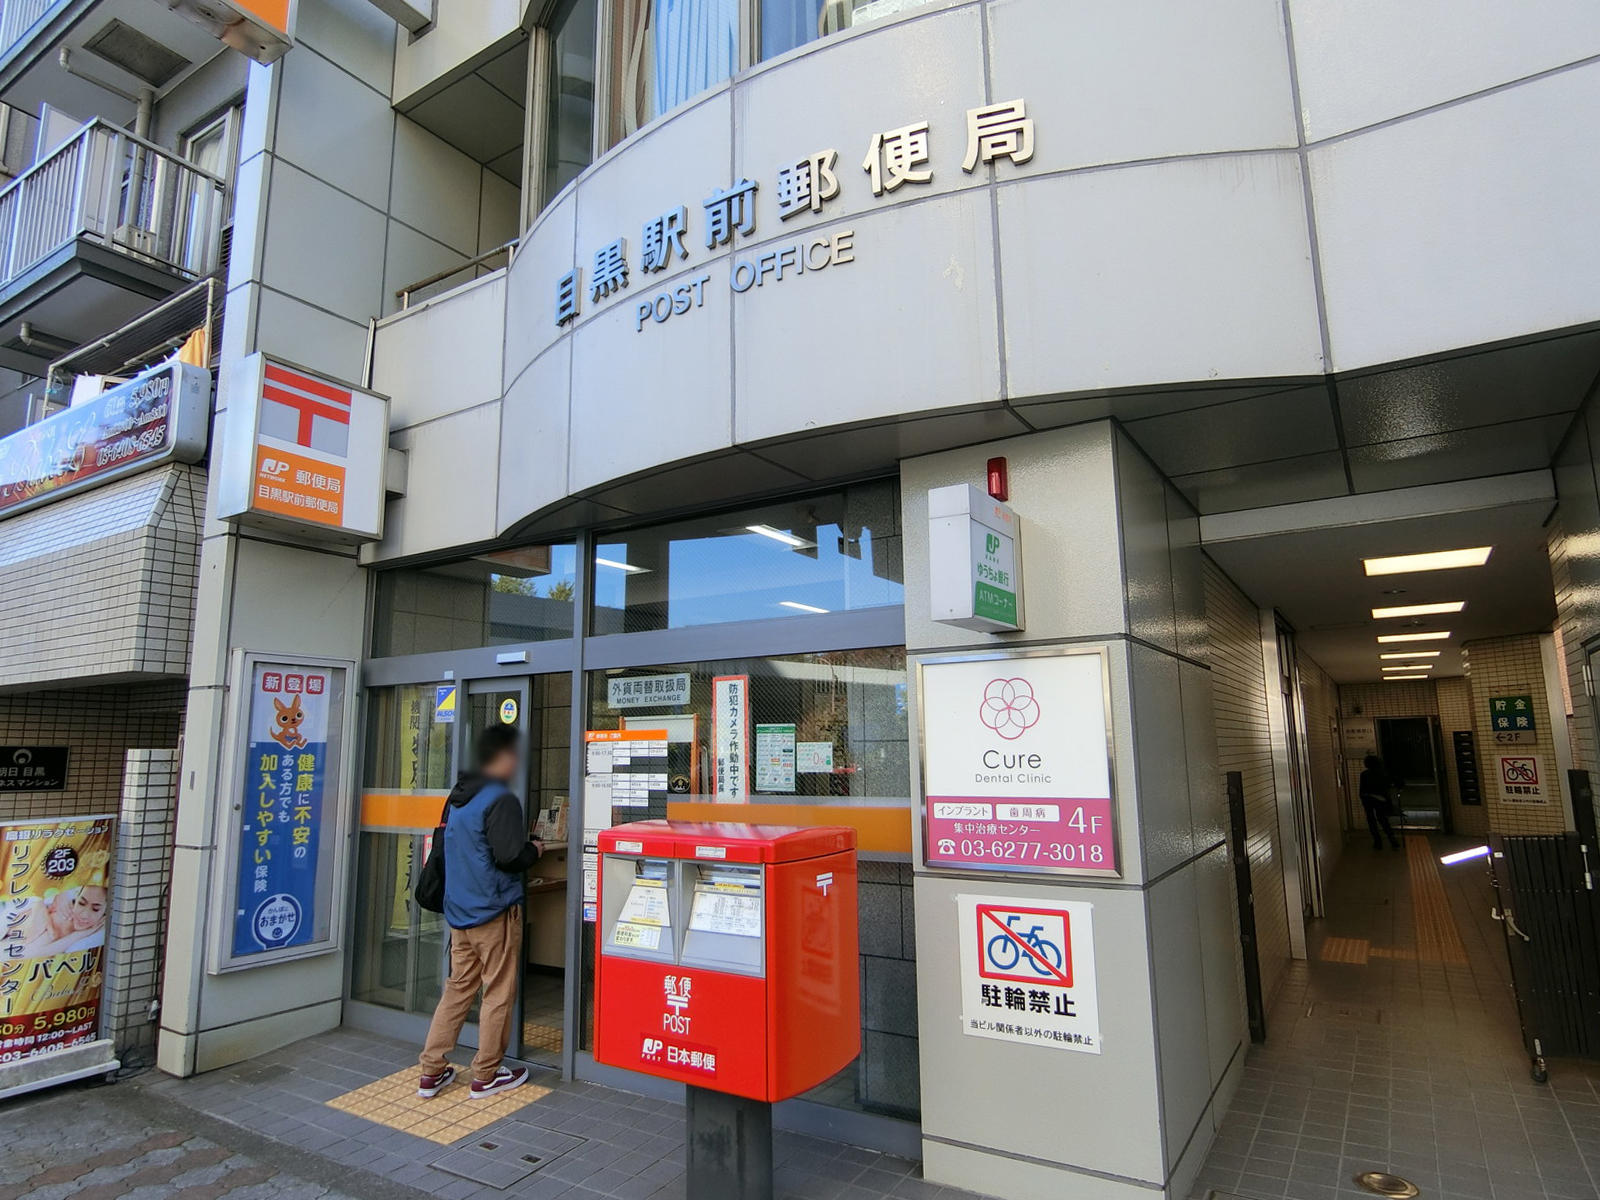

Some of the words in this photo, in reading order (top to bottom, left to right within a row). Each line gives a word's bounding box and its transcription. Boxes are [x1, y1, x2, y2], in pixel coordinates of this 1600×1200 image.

[555, 98, 1036, 327] 目黒駅前郵便局
[635, 276, 710, 332] POST
[730, 230, 855, 293] OFFICE
[261, 458, 290, 475] JP
[259, 472, 286, 483] NETWORK
[295, 469, 341, 493] 郵便局
[258, 484, 339, 515] 目黒駅前郵便局
[986, 533, 999, 554] JP
[977, 562, 1010, 586] ゆうちょ銀行
[980, 588, 1013, 609] ATMコーナー
[264, 674, 324, 693] 新登場
[612, 677, 686, 696] 外貨両替取扱局
[644, 694, 681, 703] EXCHANGE
[1495, 699, 1526, 711] 貯金
[1497, 716, 1528, 728] 保険
[728, 683, 739, 798] 防犯カメラ作動中です
[1507, 732, 1521, 742] 2F
[982, 749, 1042, 769] Cure
[23, 767, 46, 777] 目黒
[717, 758, 725, 793] 郵便局長
[974, 773, 1013, 784] Dental
[1017, 773, 1051, 784] Clinic
[278, 754, 295, 823] ある方でも
[293, 754, 315, 858] 健康に不安の
[937, 805, 988, 817] インプラント
[1009, 806, 1046, 819] 歯周病
[254, 754, 278, 893] 加入しやすい保険
[953, 822, 1040, 836] 集中治療センター
[1068, 806, 1103, 834] 4F
[54, 848, 71, 858] 2F
[960, 839, 1103, 863] 03-6277-3018
[48, 858, 75, 872] 203
[1, 845, 32, 1014] リフレッシュセンター
[260, 912, 296, 927] おまかせ
[29, 952, 96, 982] バベル
[664, 975, 692, 998] 郵便
[981, 984, 1076, 1017] 駐輪禁止
[34, 1006, 96, 1030] 5,980円
[663, 1013, 691, 1035] POST
[970, 1019, 1094, 1046] 当ビル関係者以外の駐輪禁止
[642, 1038, 663, 1055] JP
[641, 1053, 661, 1062] POST
[667, 1045, 716, 1072] 日本郵便
